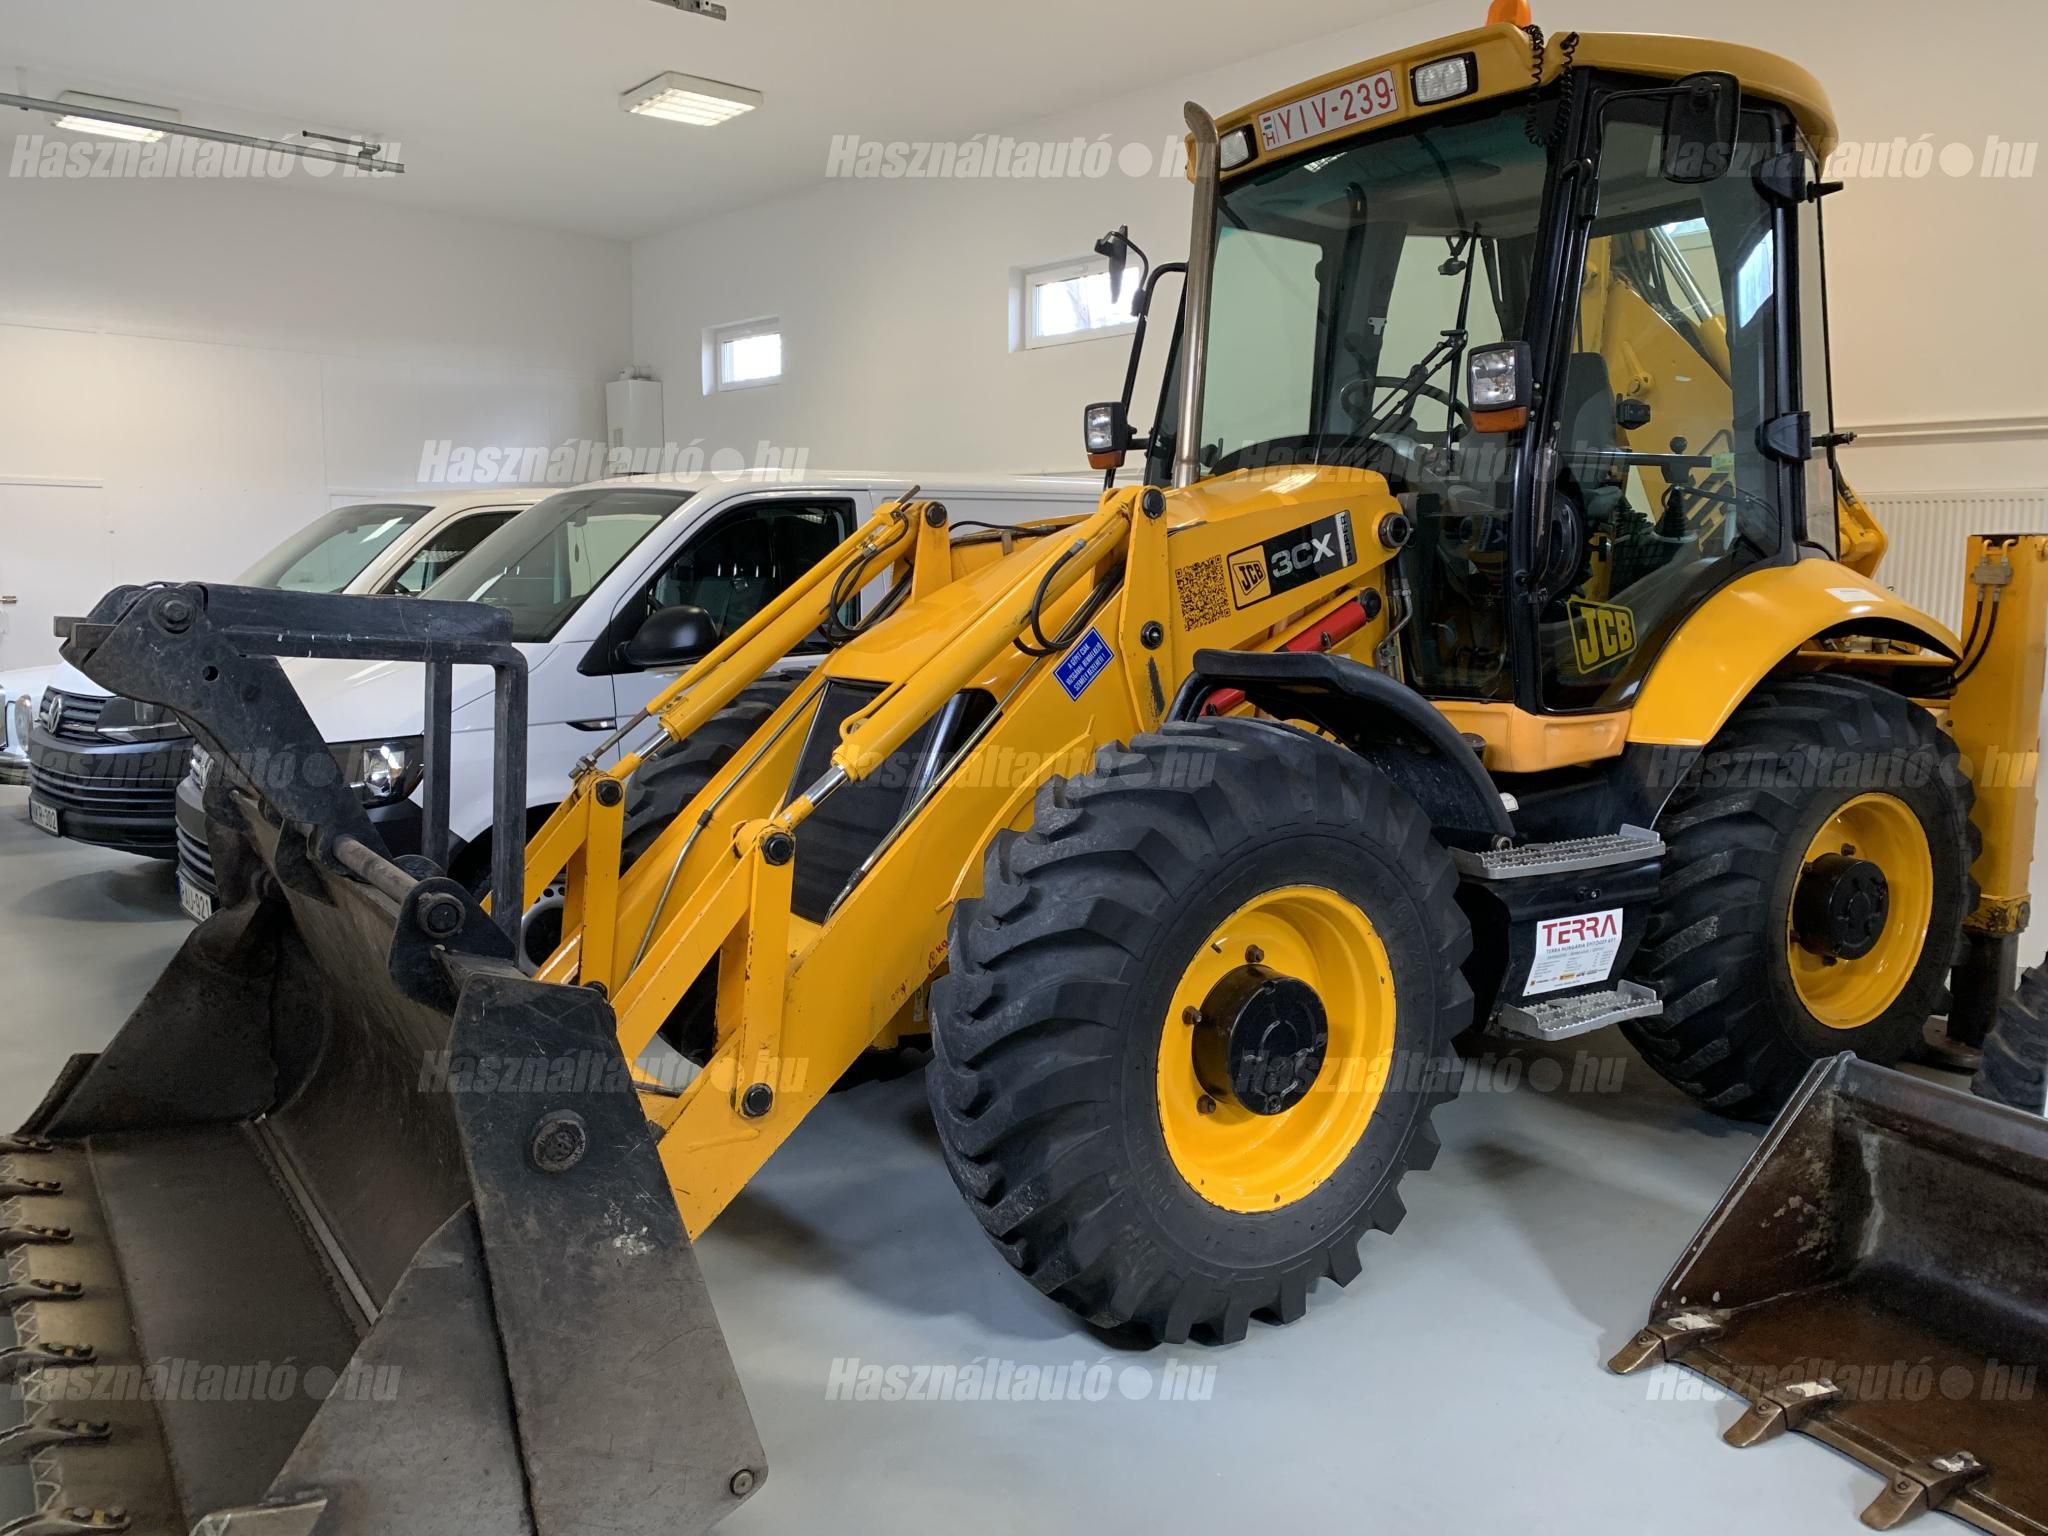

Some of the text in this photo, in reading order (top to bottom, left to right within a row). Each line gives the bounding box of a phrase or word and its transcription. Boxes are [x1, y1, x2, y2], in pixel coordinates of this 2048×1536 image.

[1278, 77, 1391, 139] YIV-239
[1239, 562, 1264, 592] JCB
[1271, 533, 1336, 578] 3CX
[1579, 606, 1633, 665] JCB
[1542, 914, 1617, 946] TERRA
